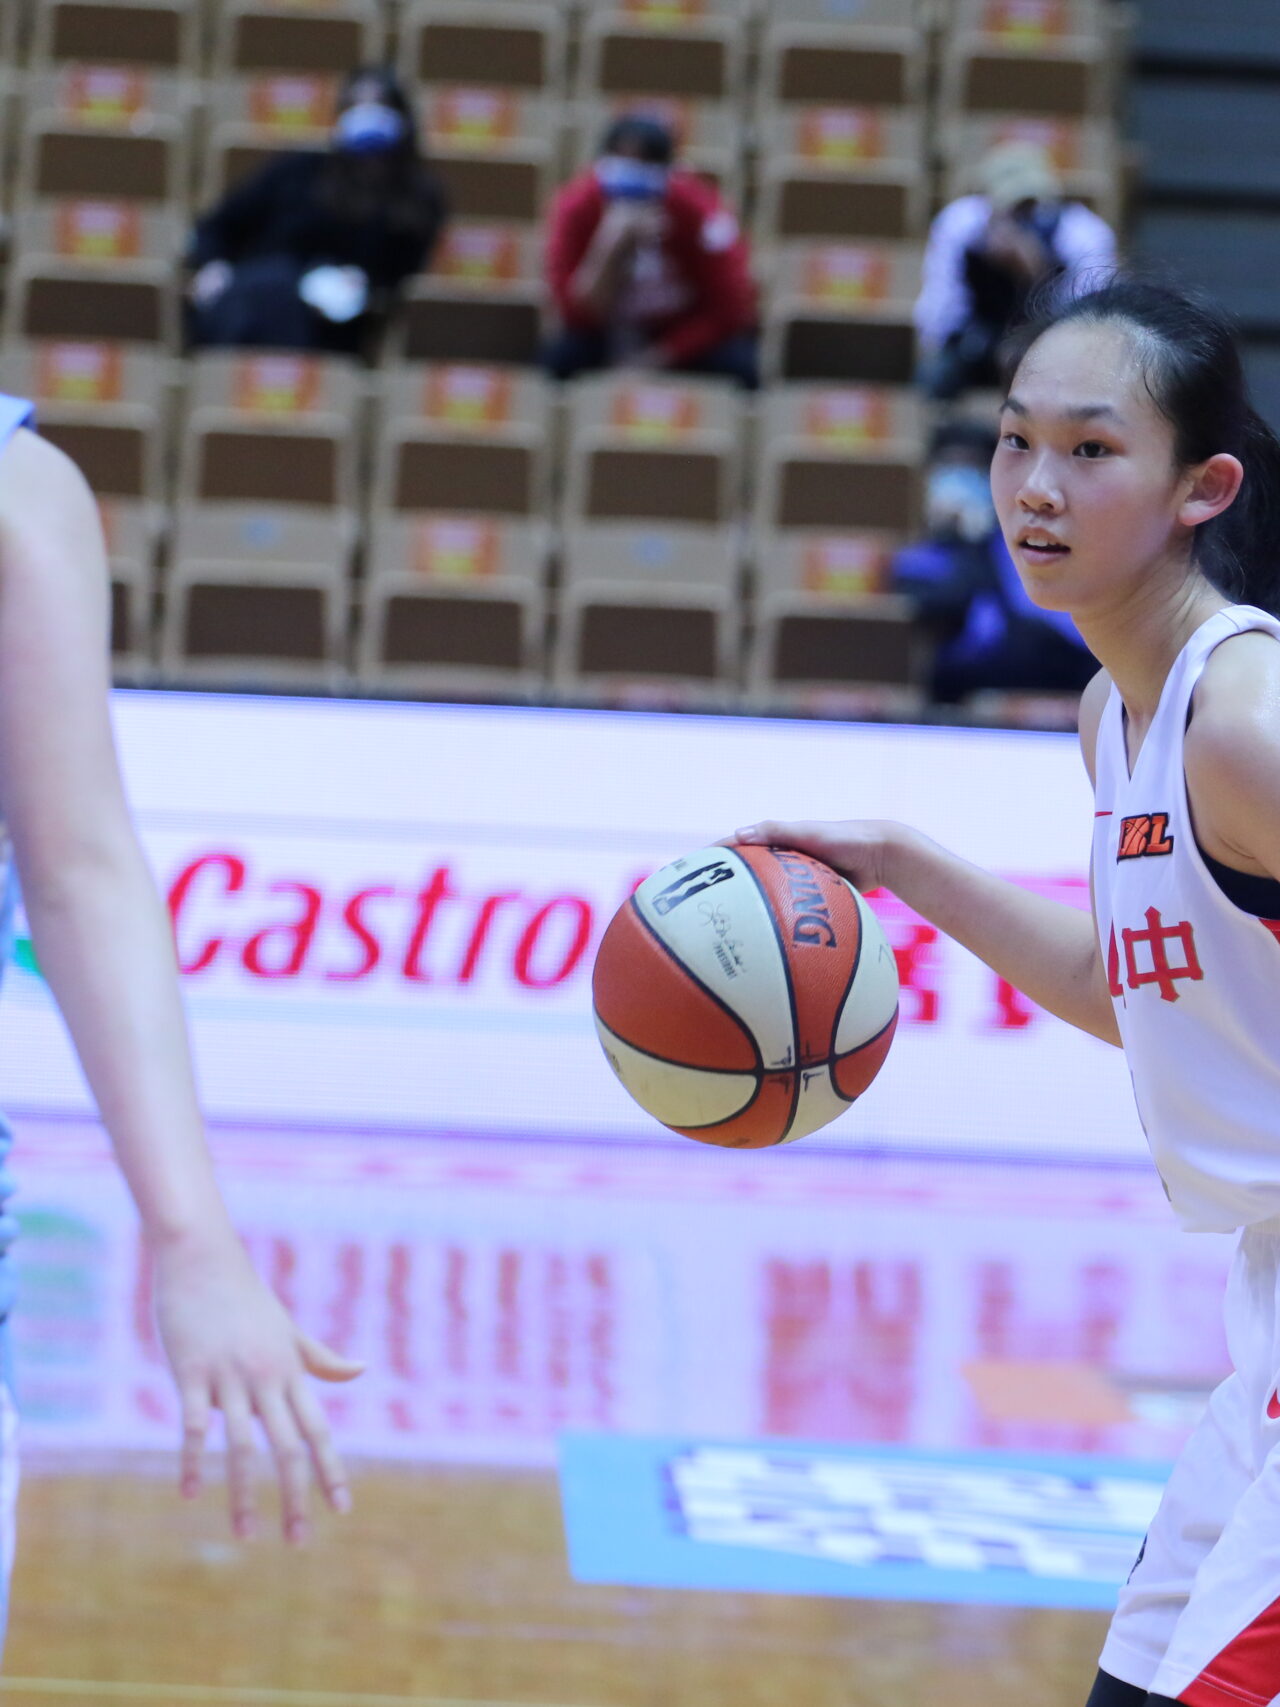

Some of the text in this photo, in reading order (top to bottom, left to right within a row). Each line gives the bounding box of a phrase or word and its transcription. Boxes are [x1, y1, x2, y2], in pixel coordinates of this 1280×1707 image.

[166, 853, 650, 990] Castro
[768, 846, 837, 948] LDING
[1108, 906, 1204, 1008] 中
